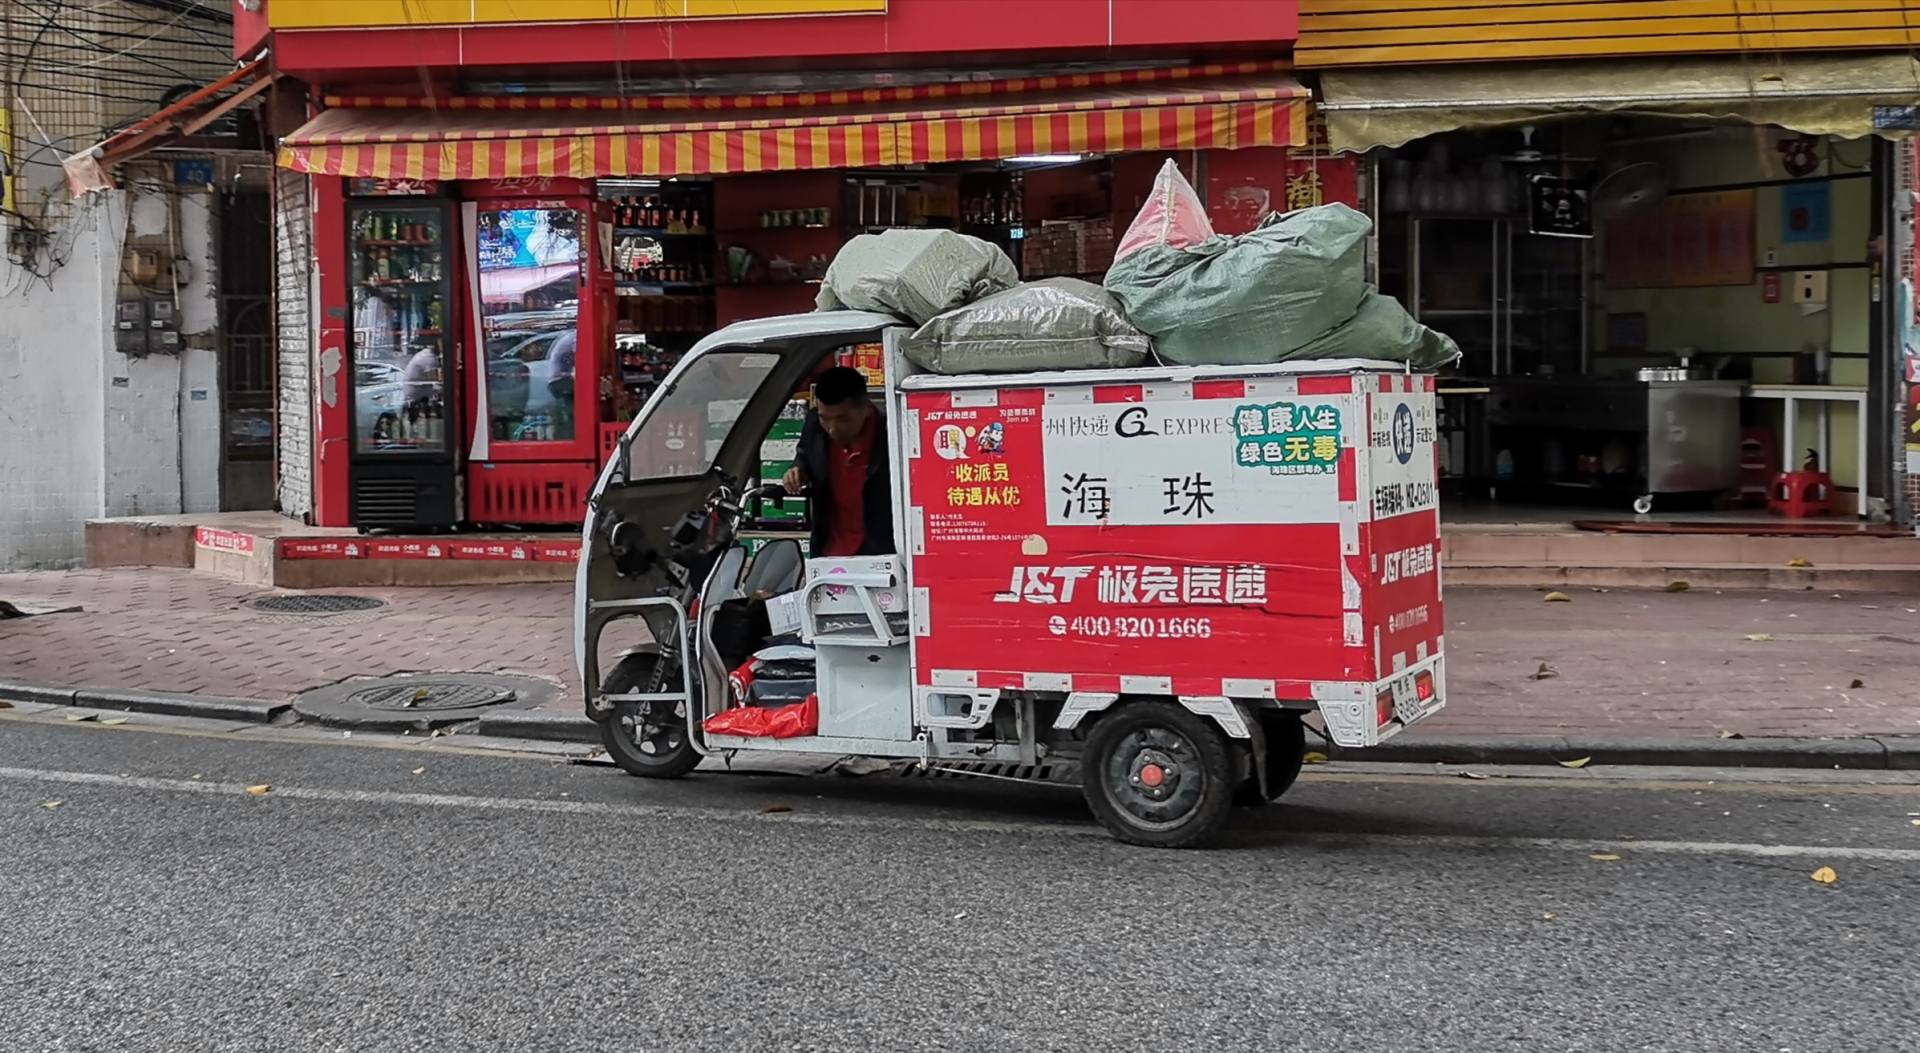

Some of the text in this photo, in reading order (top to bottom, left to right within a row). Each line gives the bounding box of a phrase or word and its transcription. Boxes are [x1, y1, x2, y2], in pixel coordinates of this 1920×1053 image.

[1238, 406, 1337, 436] 健康人生
[1395, 411, 1412, 455] 快递
[1240, 435, 1338, 462] 绿色无毒
[955, 463, 1010, 482] 收派员
[947, 486, 1020, 506] 待遇从优
[993, 564, 1268, 604] J&T 极兔速递
